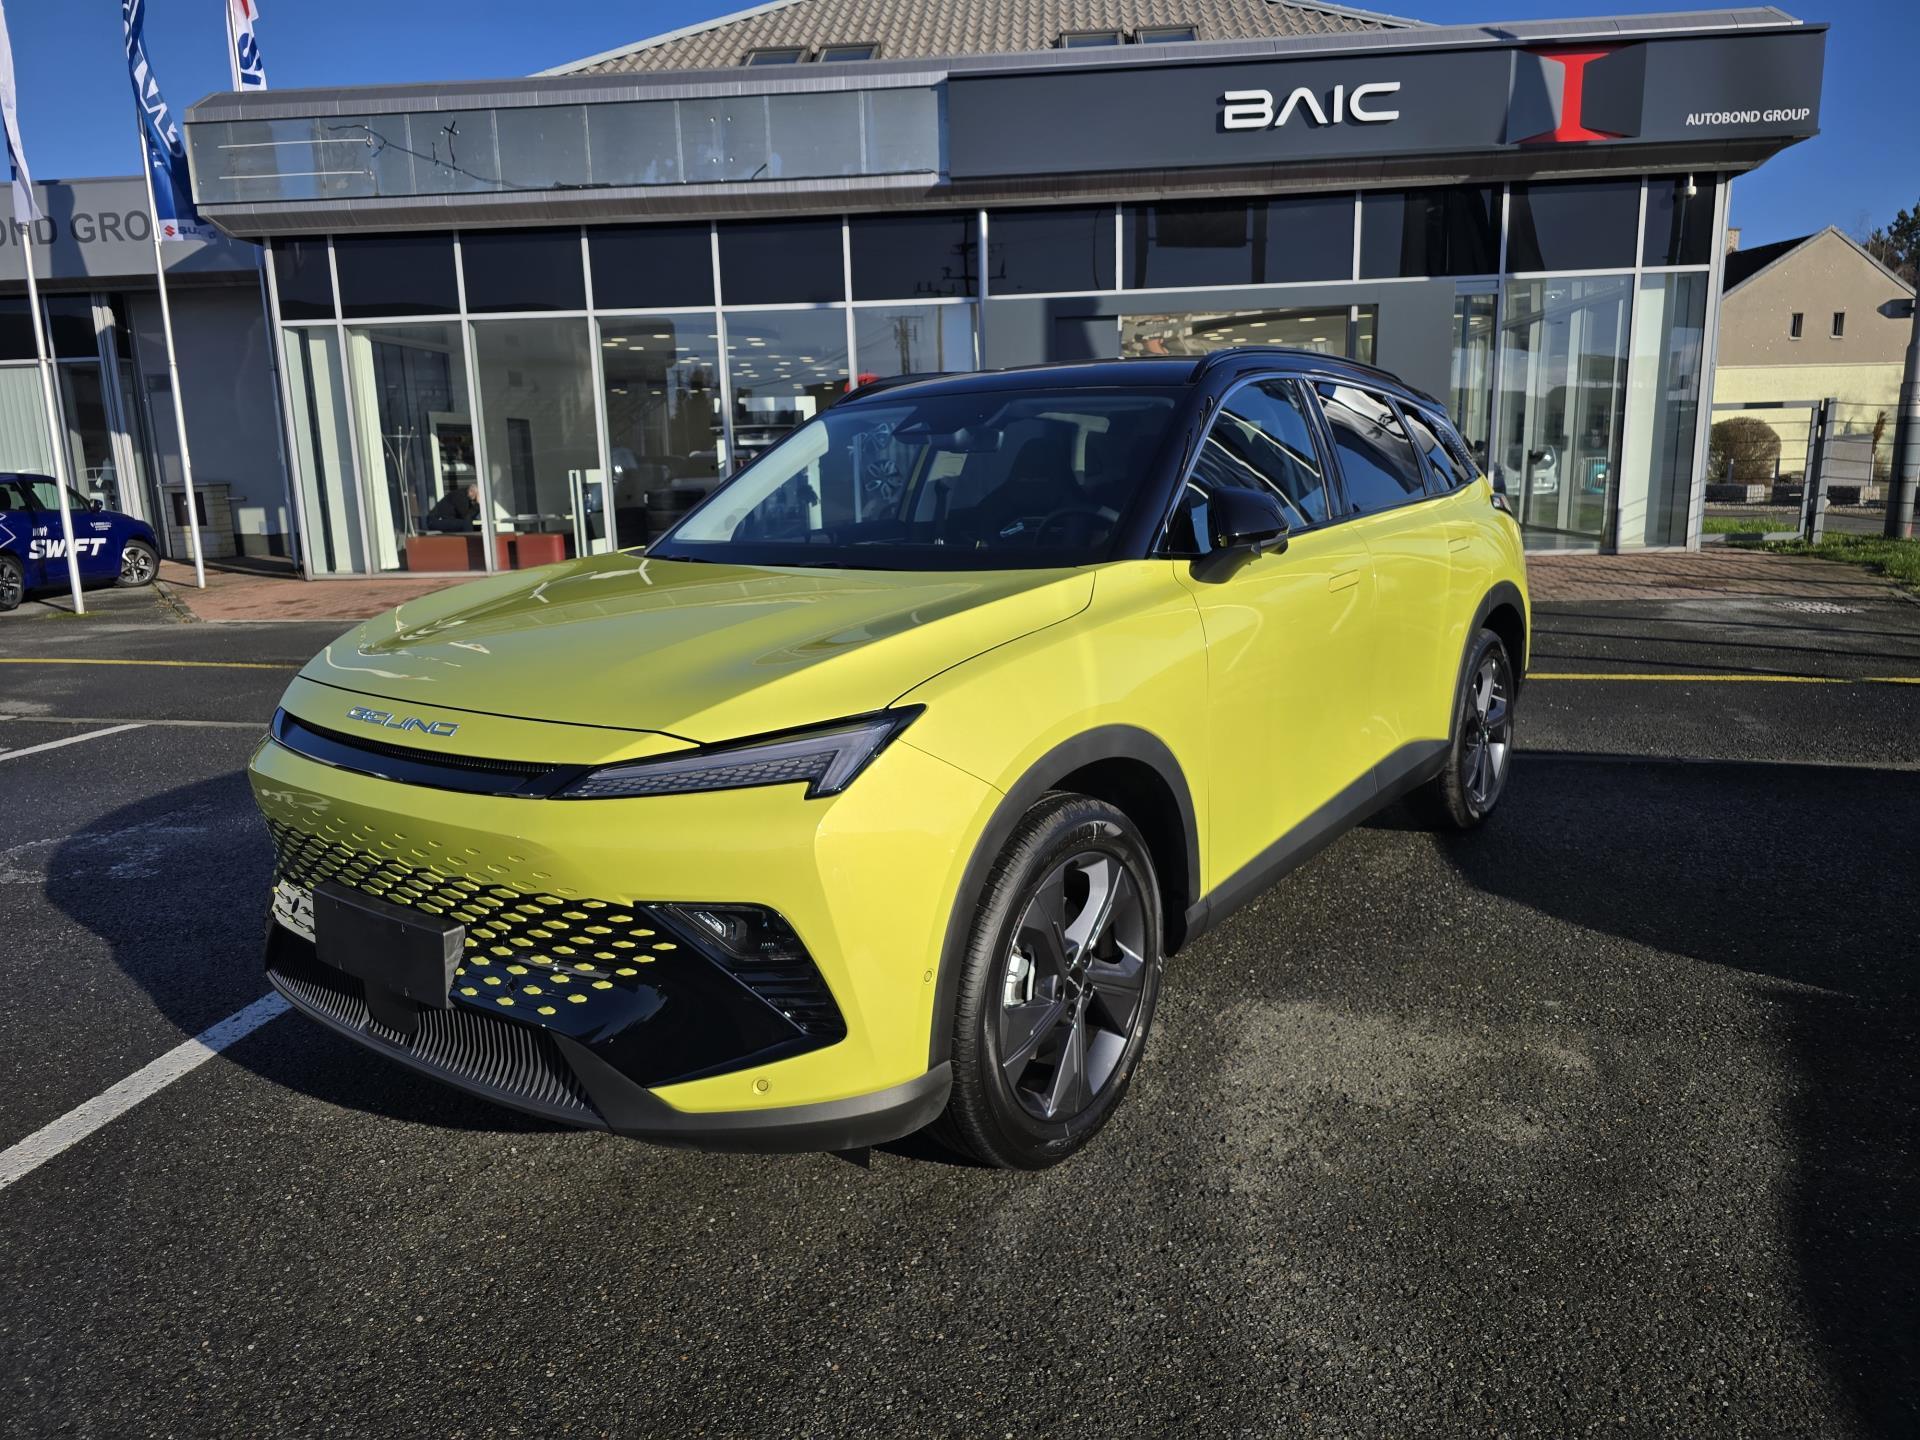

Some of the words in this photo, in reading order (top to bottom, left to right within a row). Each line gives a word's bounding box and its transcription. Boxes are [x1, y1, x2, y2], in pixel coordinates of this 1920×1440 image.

[1224, 81, 1401, 129] BAIC
[1685, 110, 1761, 126] AUTOBOND
[1762, 107, 1810, 122] GROUP
[28, 537, 107, 560] SWFT
